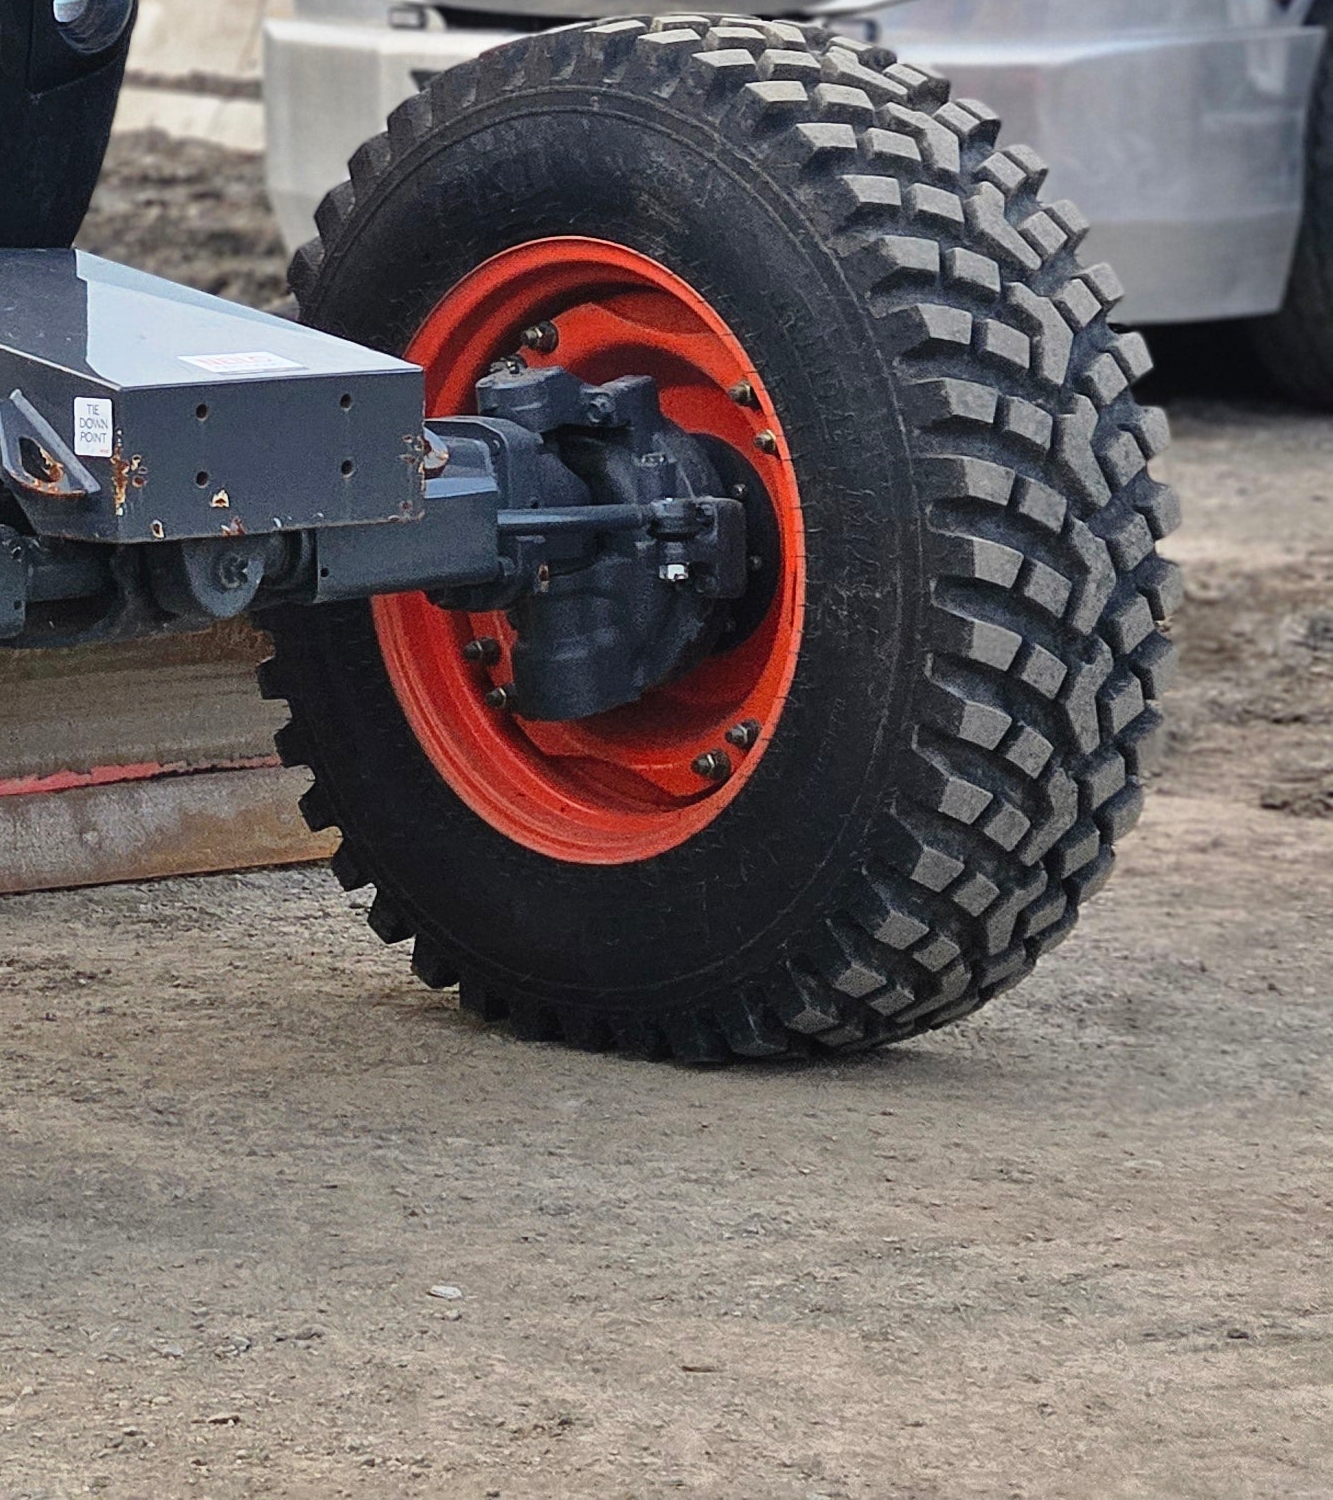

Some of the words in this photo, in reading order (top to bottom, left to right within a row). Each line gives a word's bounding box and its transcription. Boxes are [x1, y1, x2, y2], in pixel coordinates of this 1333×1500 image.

[86, 403, 100, 416] TIE
[79, 417, 109, 430] DOWN
[80, 431, 107, 443] POINT
